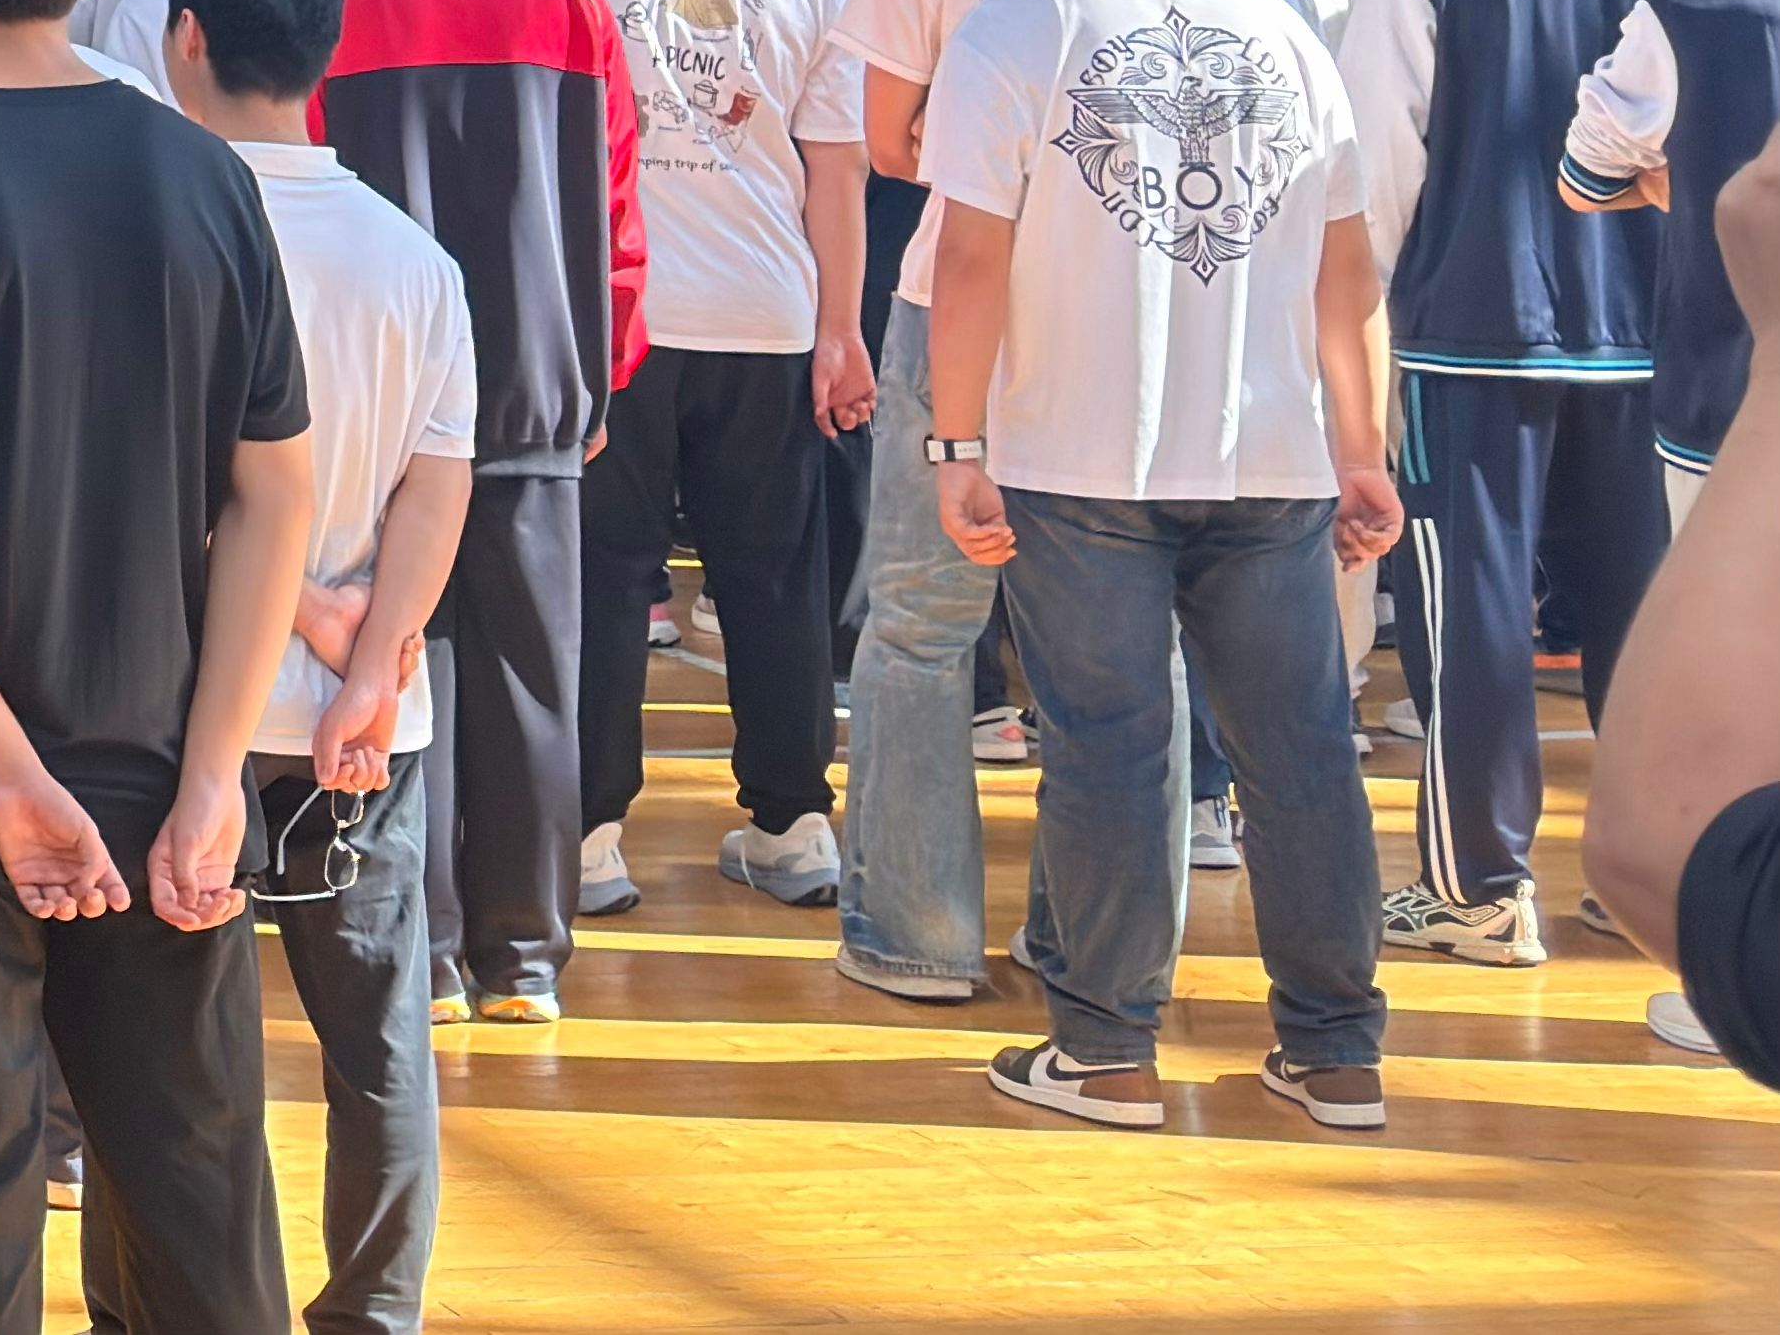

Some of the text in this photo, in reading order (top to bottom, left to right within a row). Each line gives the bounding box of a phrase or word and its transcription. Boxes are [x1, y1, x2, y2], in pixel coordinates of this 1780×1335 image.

[665, 45, 727, 81] PICNIC
[1079, 34, 1135, 87] BOY
[674, 158, 698, 172] trip
[701, 160, 717, 173] of
[1141, 165, 1256, 210] BOY
